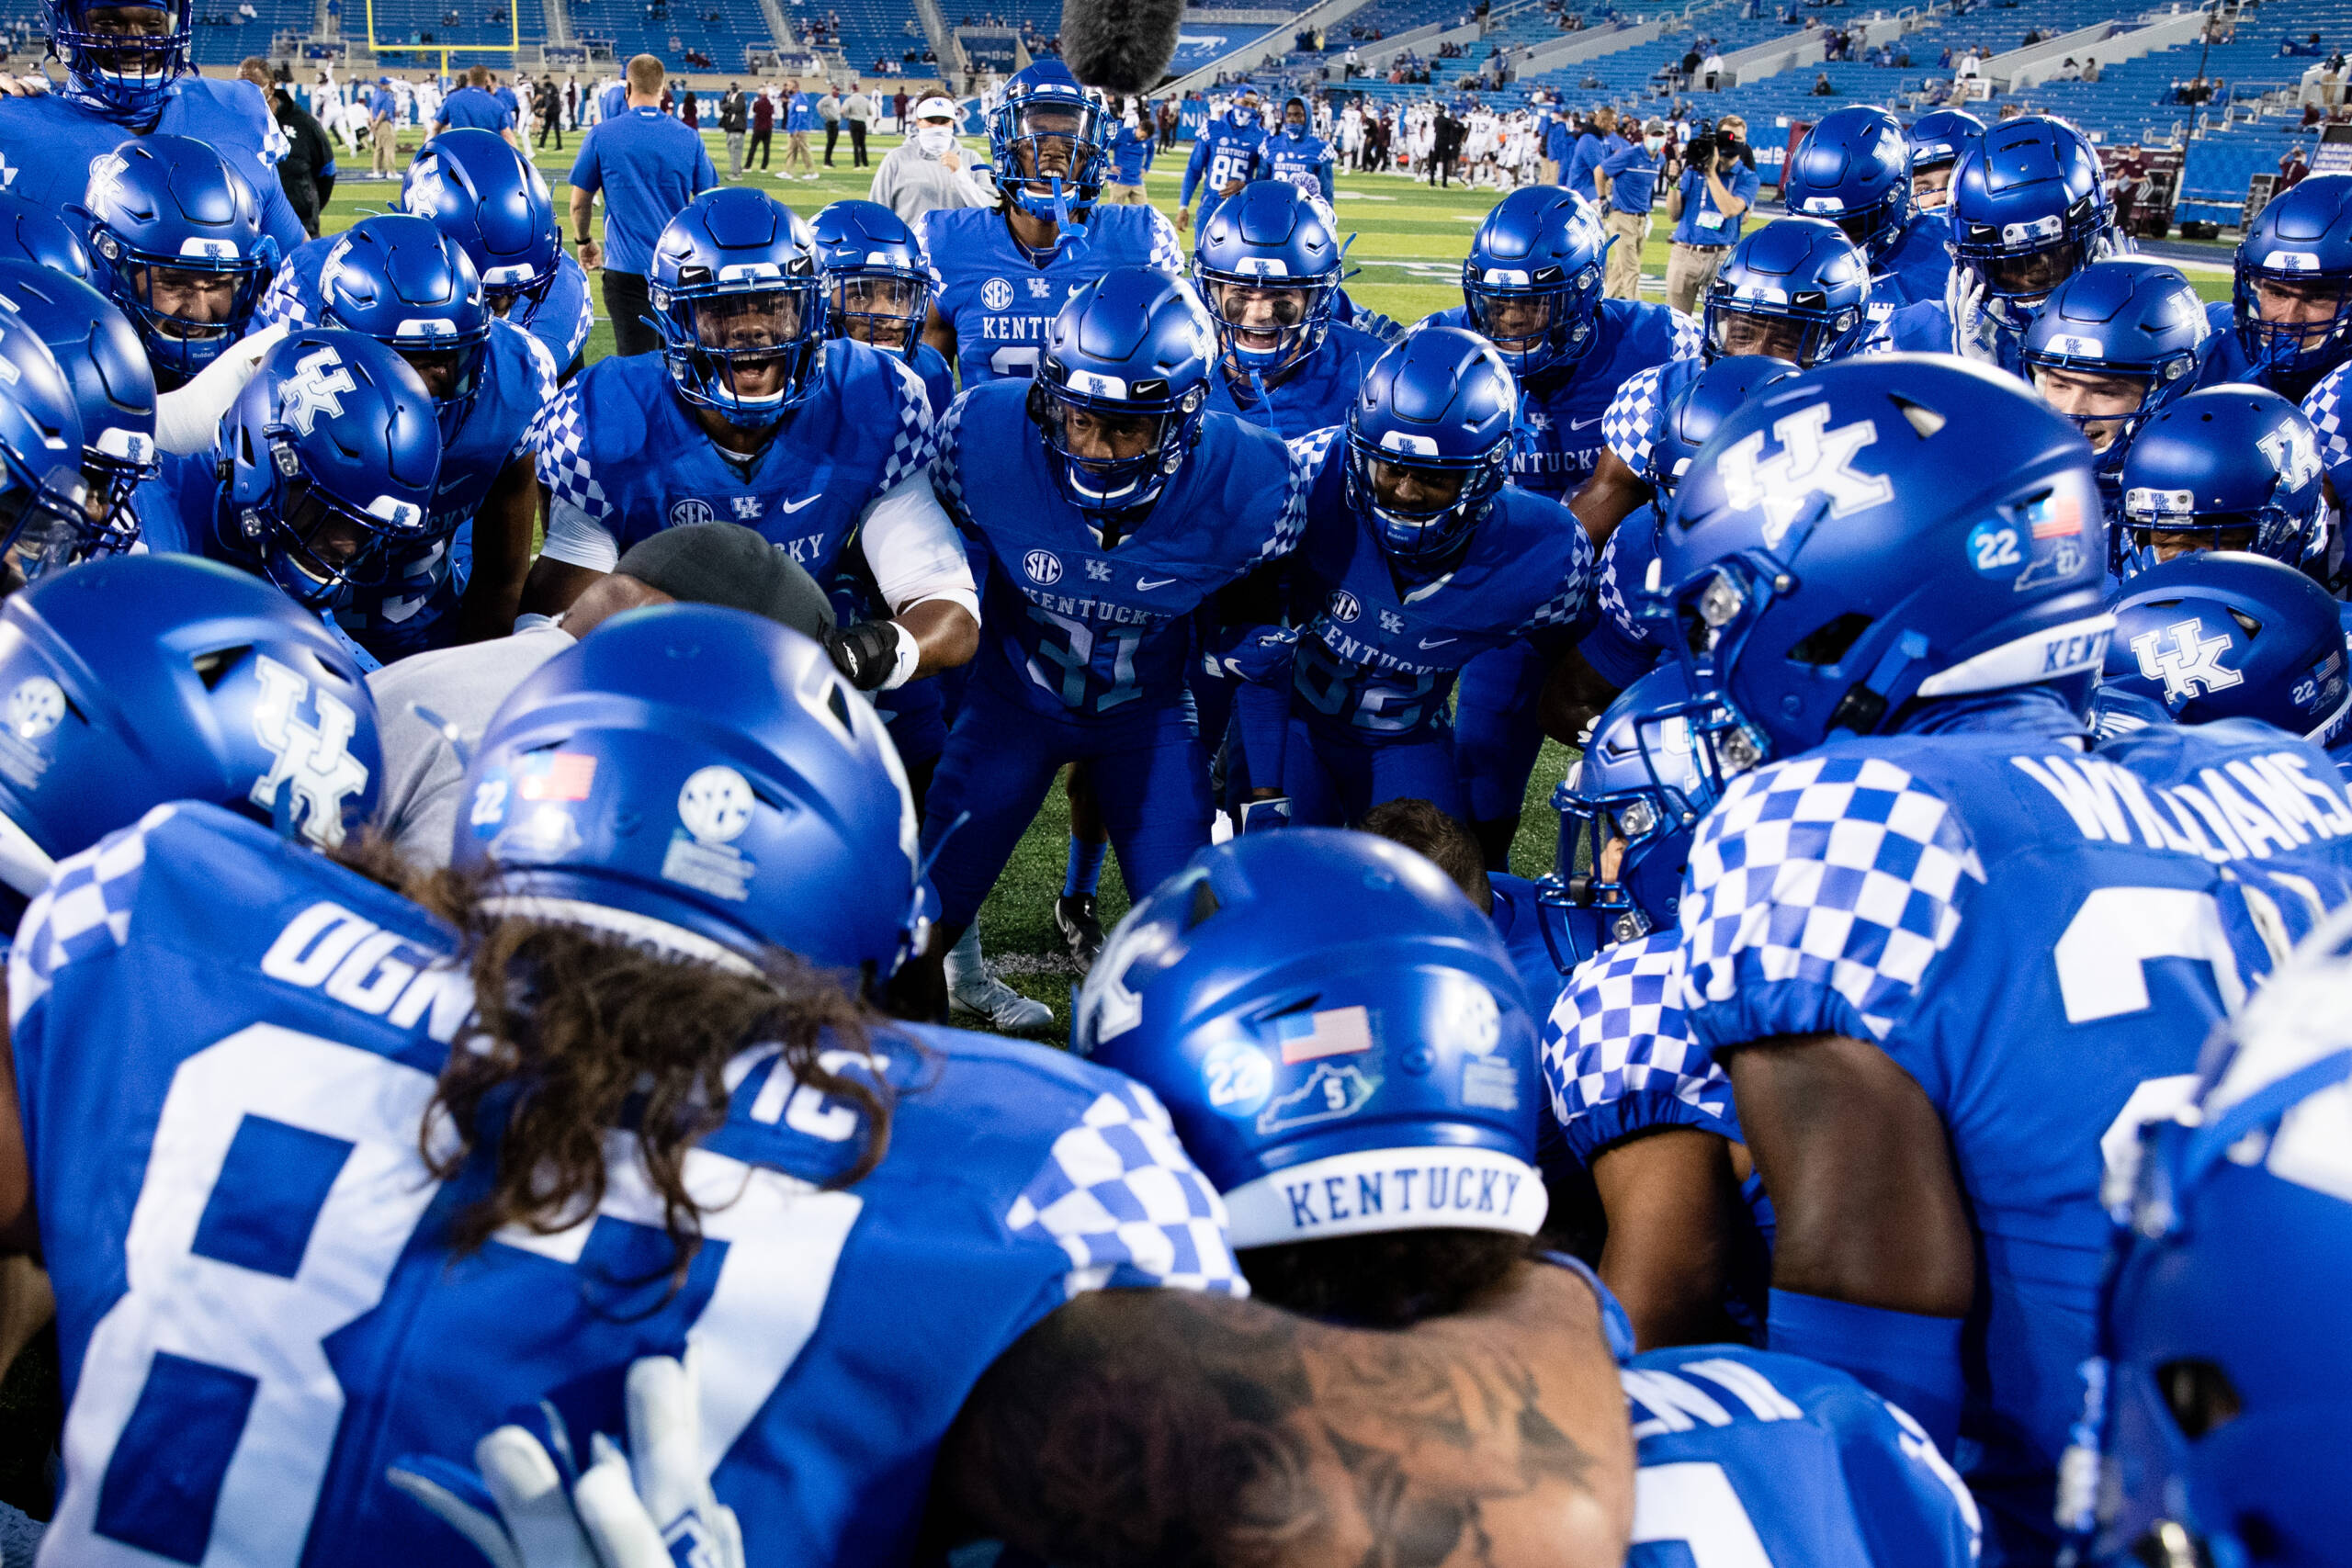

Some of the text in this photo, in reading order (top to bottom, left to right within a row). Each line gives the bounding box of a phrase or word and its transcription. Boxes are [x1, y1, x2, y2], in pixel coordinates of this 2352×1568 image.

[1209, 154, 1249, 191] 85
[985, 280, 1011, 309] SEC
[1027, 277, 1050, 299] UK
[277, 345, 356, 437] UK
[1717, 401, 1895, 551] UK
[732, 496, 763, 520] UK
[1027, 553, 1059, 583] SEC
[1975, 528, 2020, 570] 22
[1022, 586, 1171, 626] KENTUCK
[2130, 617, 2245, 705] UK
[2292, 680, 2316, 705] 22
[249, 654, 369, 854] UK
[1323, 1077, 1347, 1111] 5
[1286, 1167, 1521, 1228] KENTUCKY
